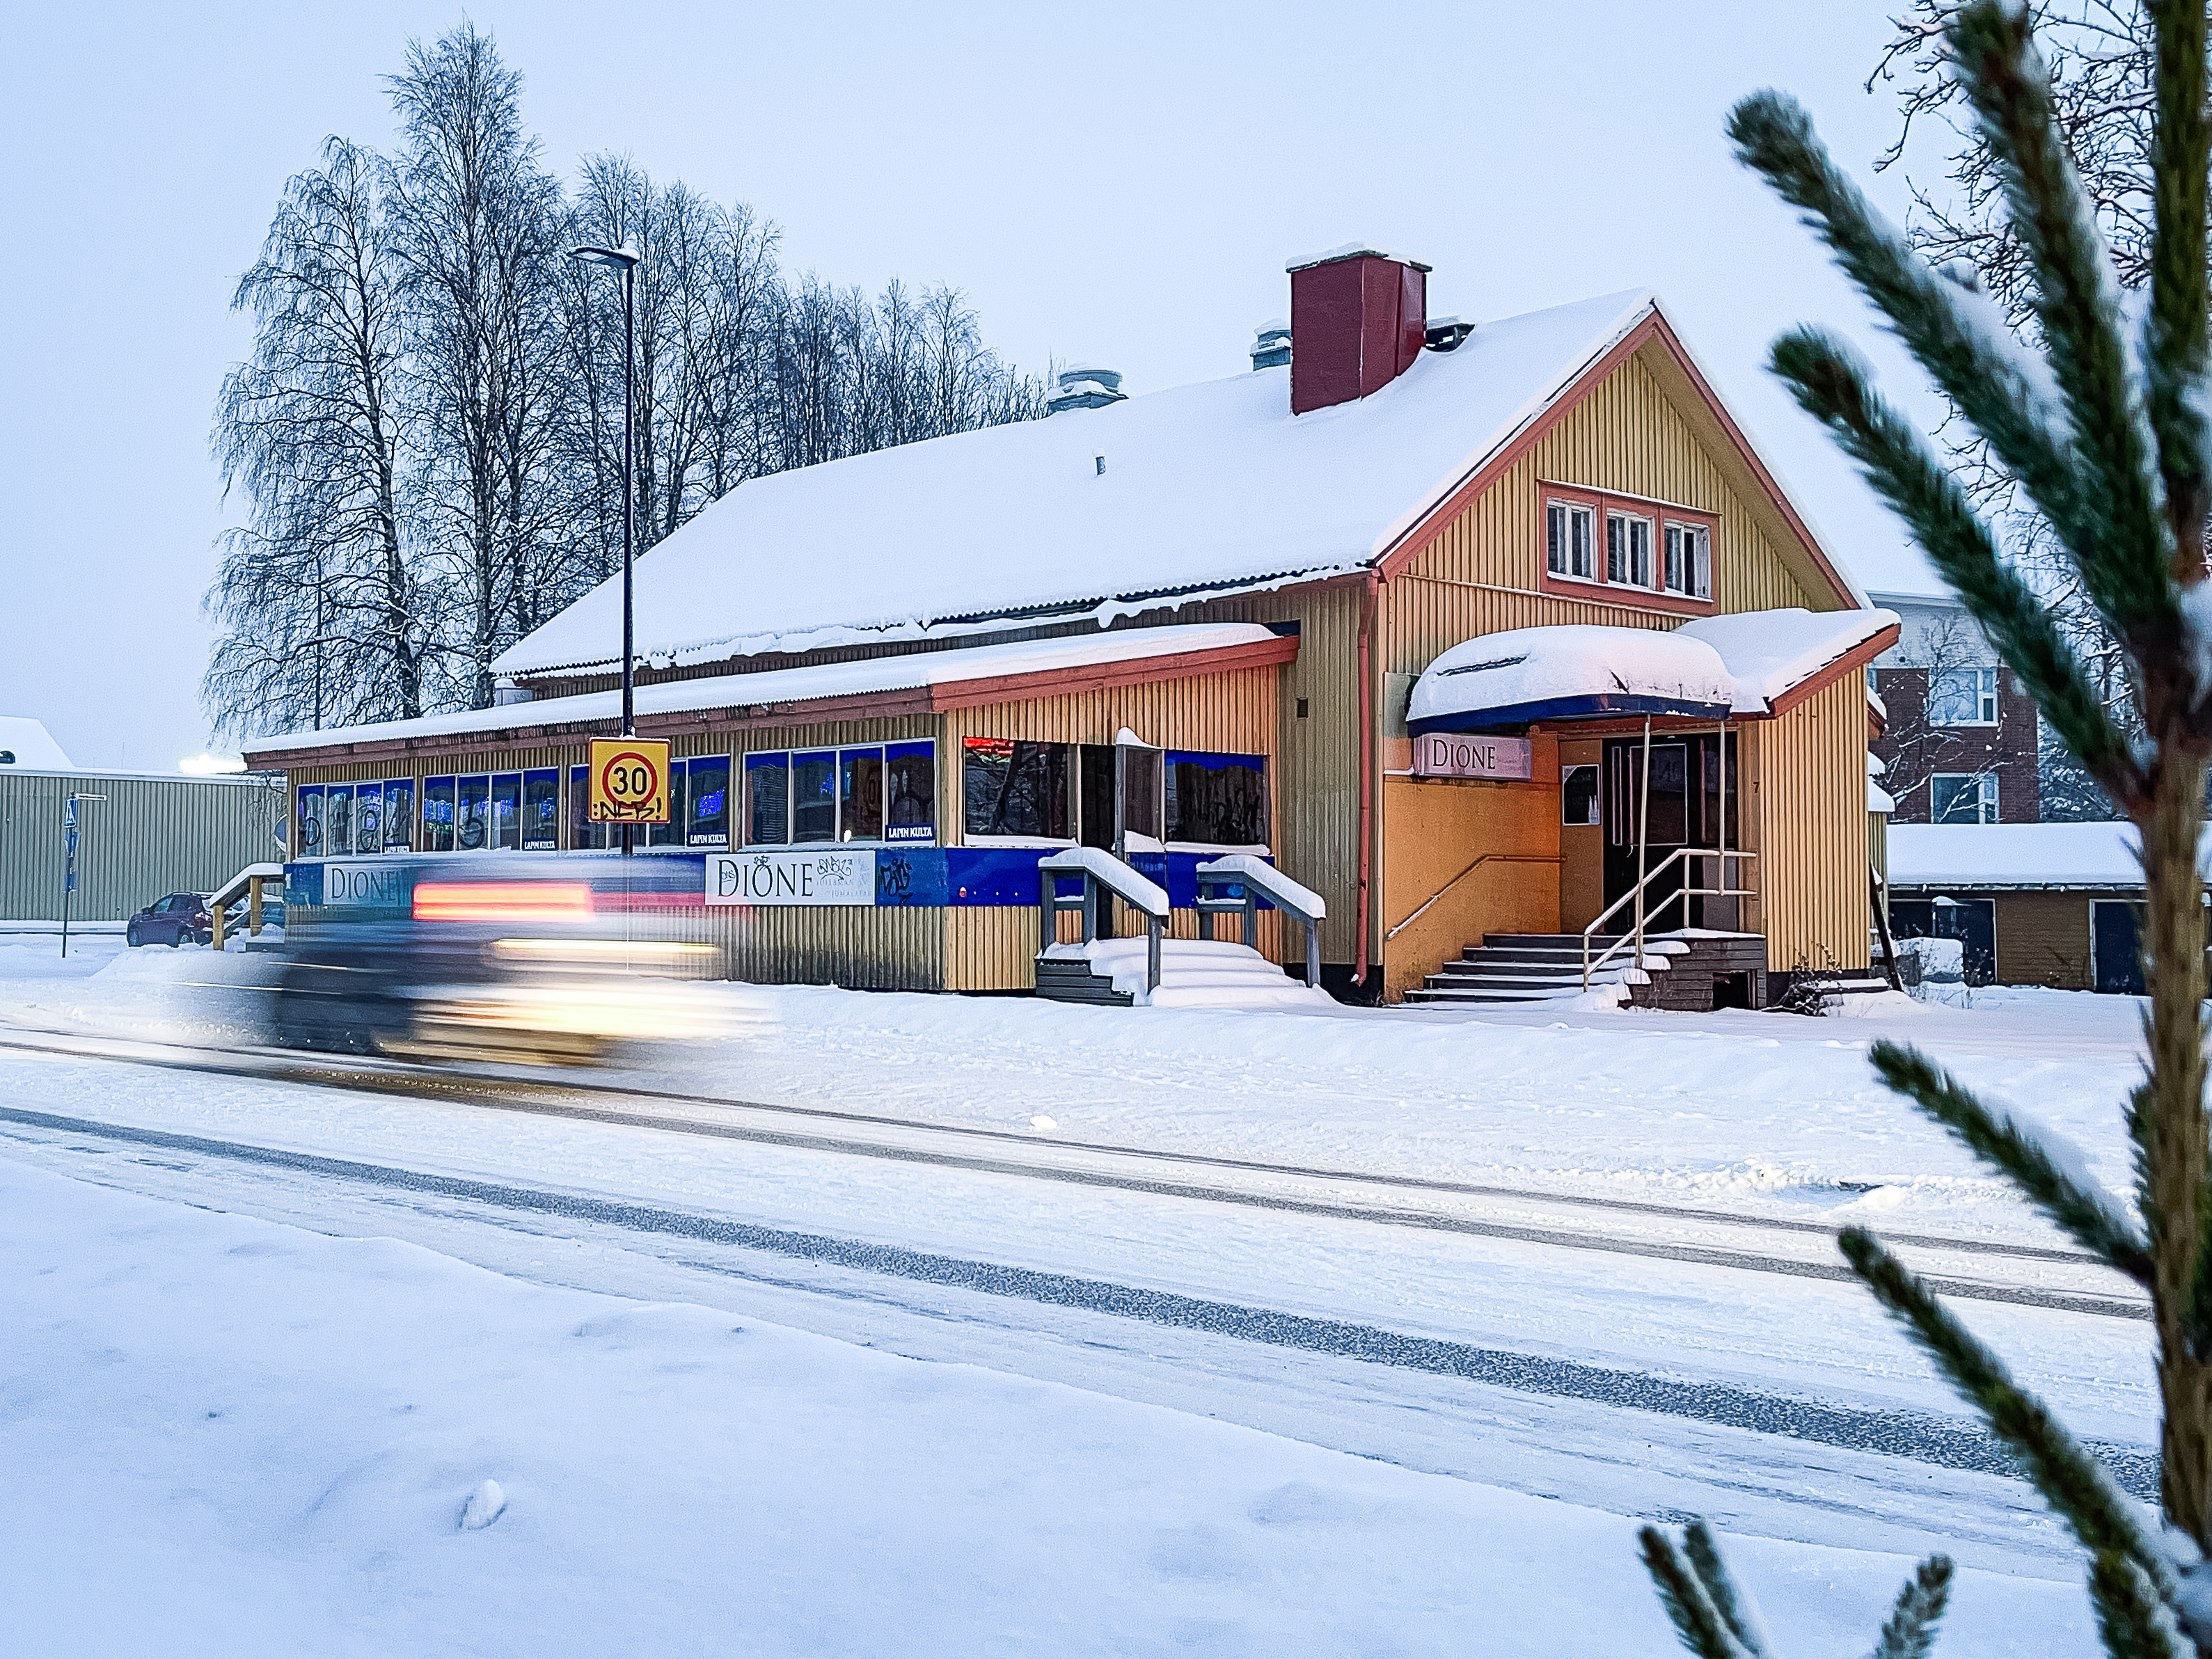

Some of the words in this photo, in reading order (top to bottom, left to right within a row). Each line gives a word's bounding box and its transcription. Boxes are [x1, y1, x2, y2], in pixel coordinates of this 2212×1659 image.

[1432, 739, 1496, 770] DIONE
[613, 766, 647, 795] 30
[1753, 781, 1760, 794] 7
[888, 827, 909, 838] LAPIN
[909, 826, 933, 837] KULTA
[331, 868, 396, 901] DIONE
[716, 859, 814, 898] DIONE
